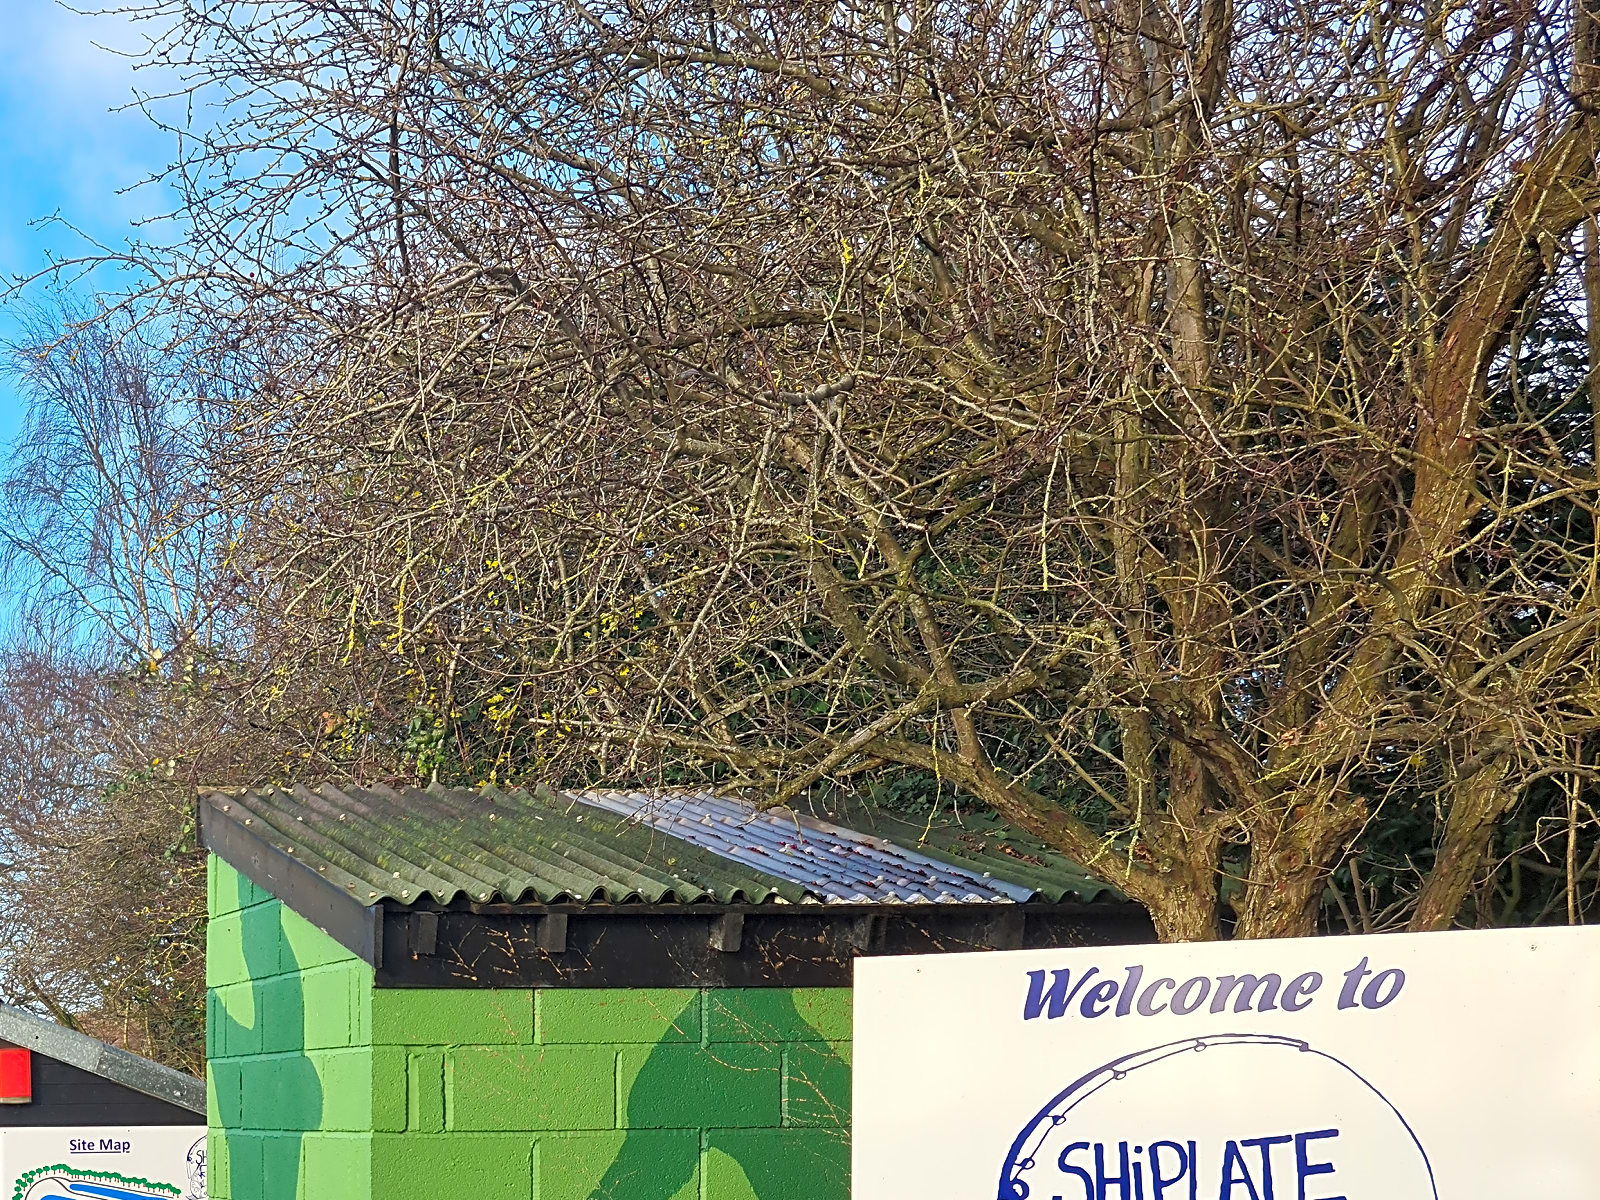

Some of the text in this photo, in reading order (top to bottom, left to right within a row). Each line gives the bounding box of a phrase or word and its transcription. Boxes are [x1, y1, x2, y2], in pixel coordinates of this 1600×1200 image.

[1023, 956, 1406, 1020] Welcome to
[69, 1139, 131, 1153] Site Map
